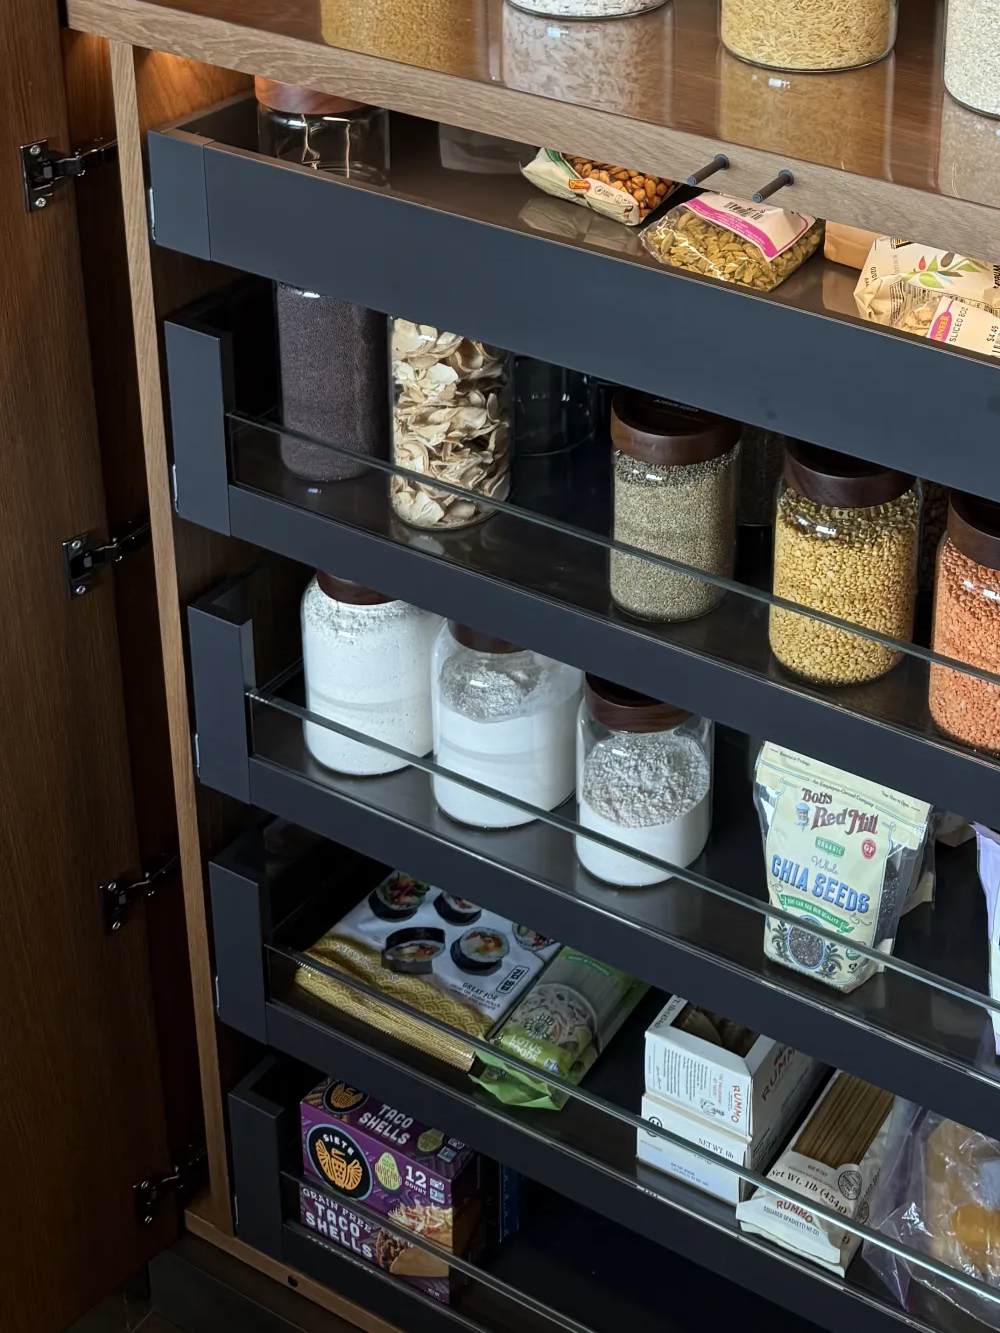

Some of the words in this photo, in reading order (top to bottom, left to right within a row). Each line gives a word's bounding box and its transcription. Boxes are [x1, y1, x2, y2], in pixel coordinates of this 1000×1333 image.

[950, 318, 964, 343] SLICED
[986, 325, 999, 342] $4.49
[802, 787, 833, 805] Bob's
[810, 805, 849, 830] Red
[844, 809, 880, 835] Mill
[811, 855, 839, 875] Whole
[771, 854, 809, 892] CHIA
[812, 872, 871, 914] SEEDS
[462, 981, 483, 996] GREAT
[483, 991, 498, 1002] FOR
[500, 968, 523, 991] 김밥
[508, 1040, 538, 1063] FOODS
[510, 1034, 543, 1055] LOTUS
[379, 1103, 414, 1129] TACO
[731, 1085, 743, 1124] RUMMO
[358, 1112, 411, 1145] SHELLS
[322, 1133, 354, 1156] SIETE
[698, 1137, 712, 1149] NET
[404, 1181, 427, 1195] COUNT
[405, 1165, 427, 1189] 12
[770, 1169, 785, 1179] Net
[787, 1173, 802, 1185] Wt.
[820, 1187, 847, 1214] (454g)
[302, 1187, 339, 1211] GRAIN
[342, 1208, 373, 1234] FREE
[314, 1201, 361, 1238] TACO
[763, 1205, 783, 1219] SQUARED
[783, 1215, 807, 1231] SPAGHETTI
[776, 1200, 814, 1224] RUMMO
[305, 1211, 373, 1259] SHELLS
